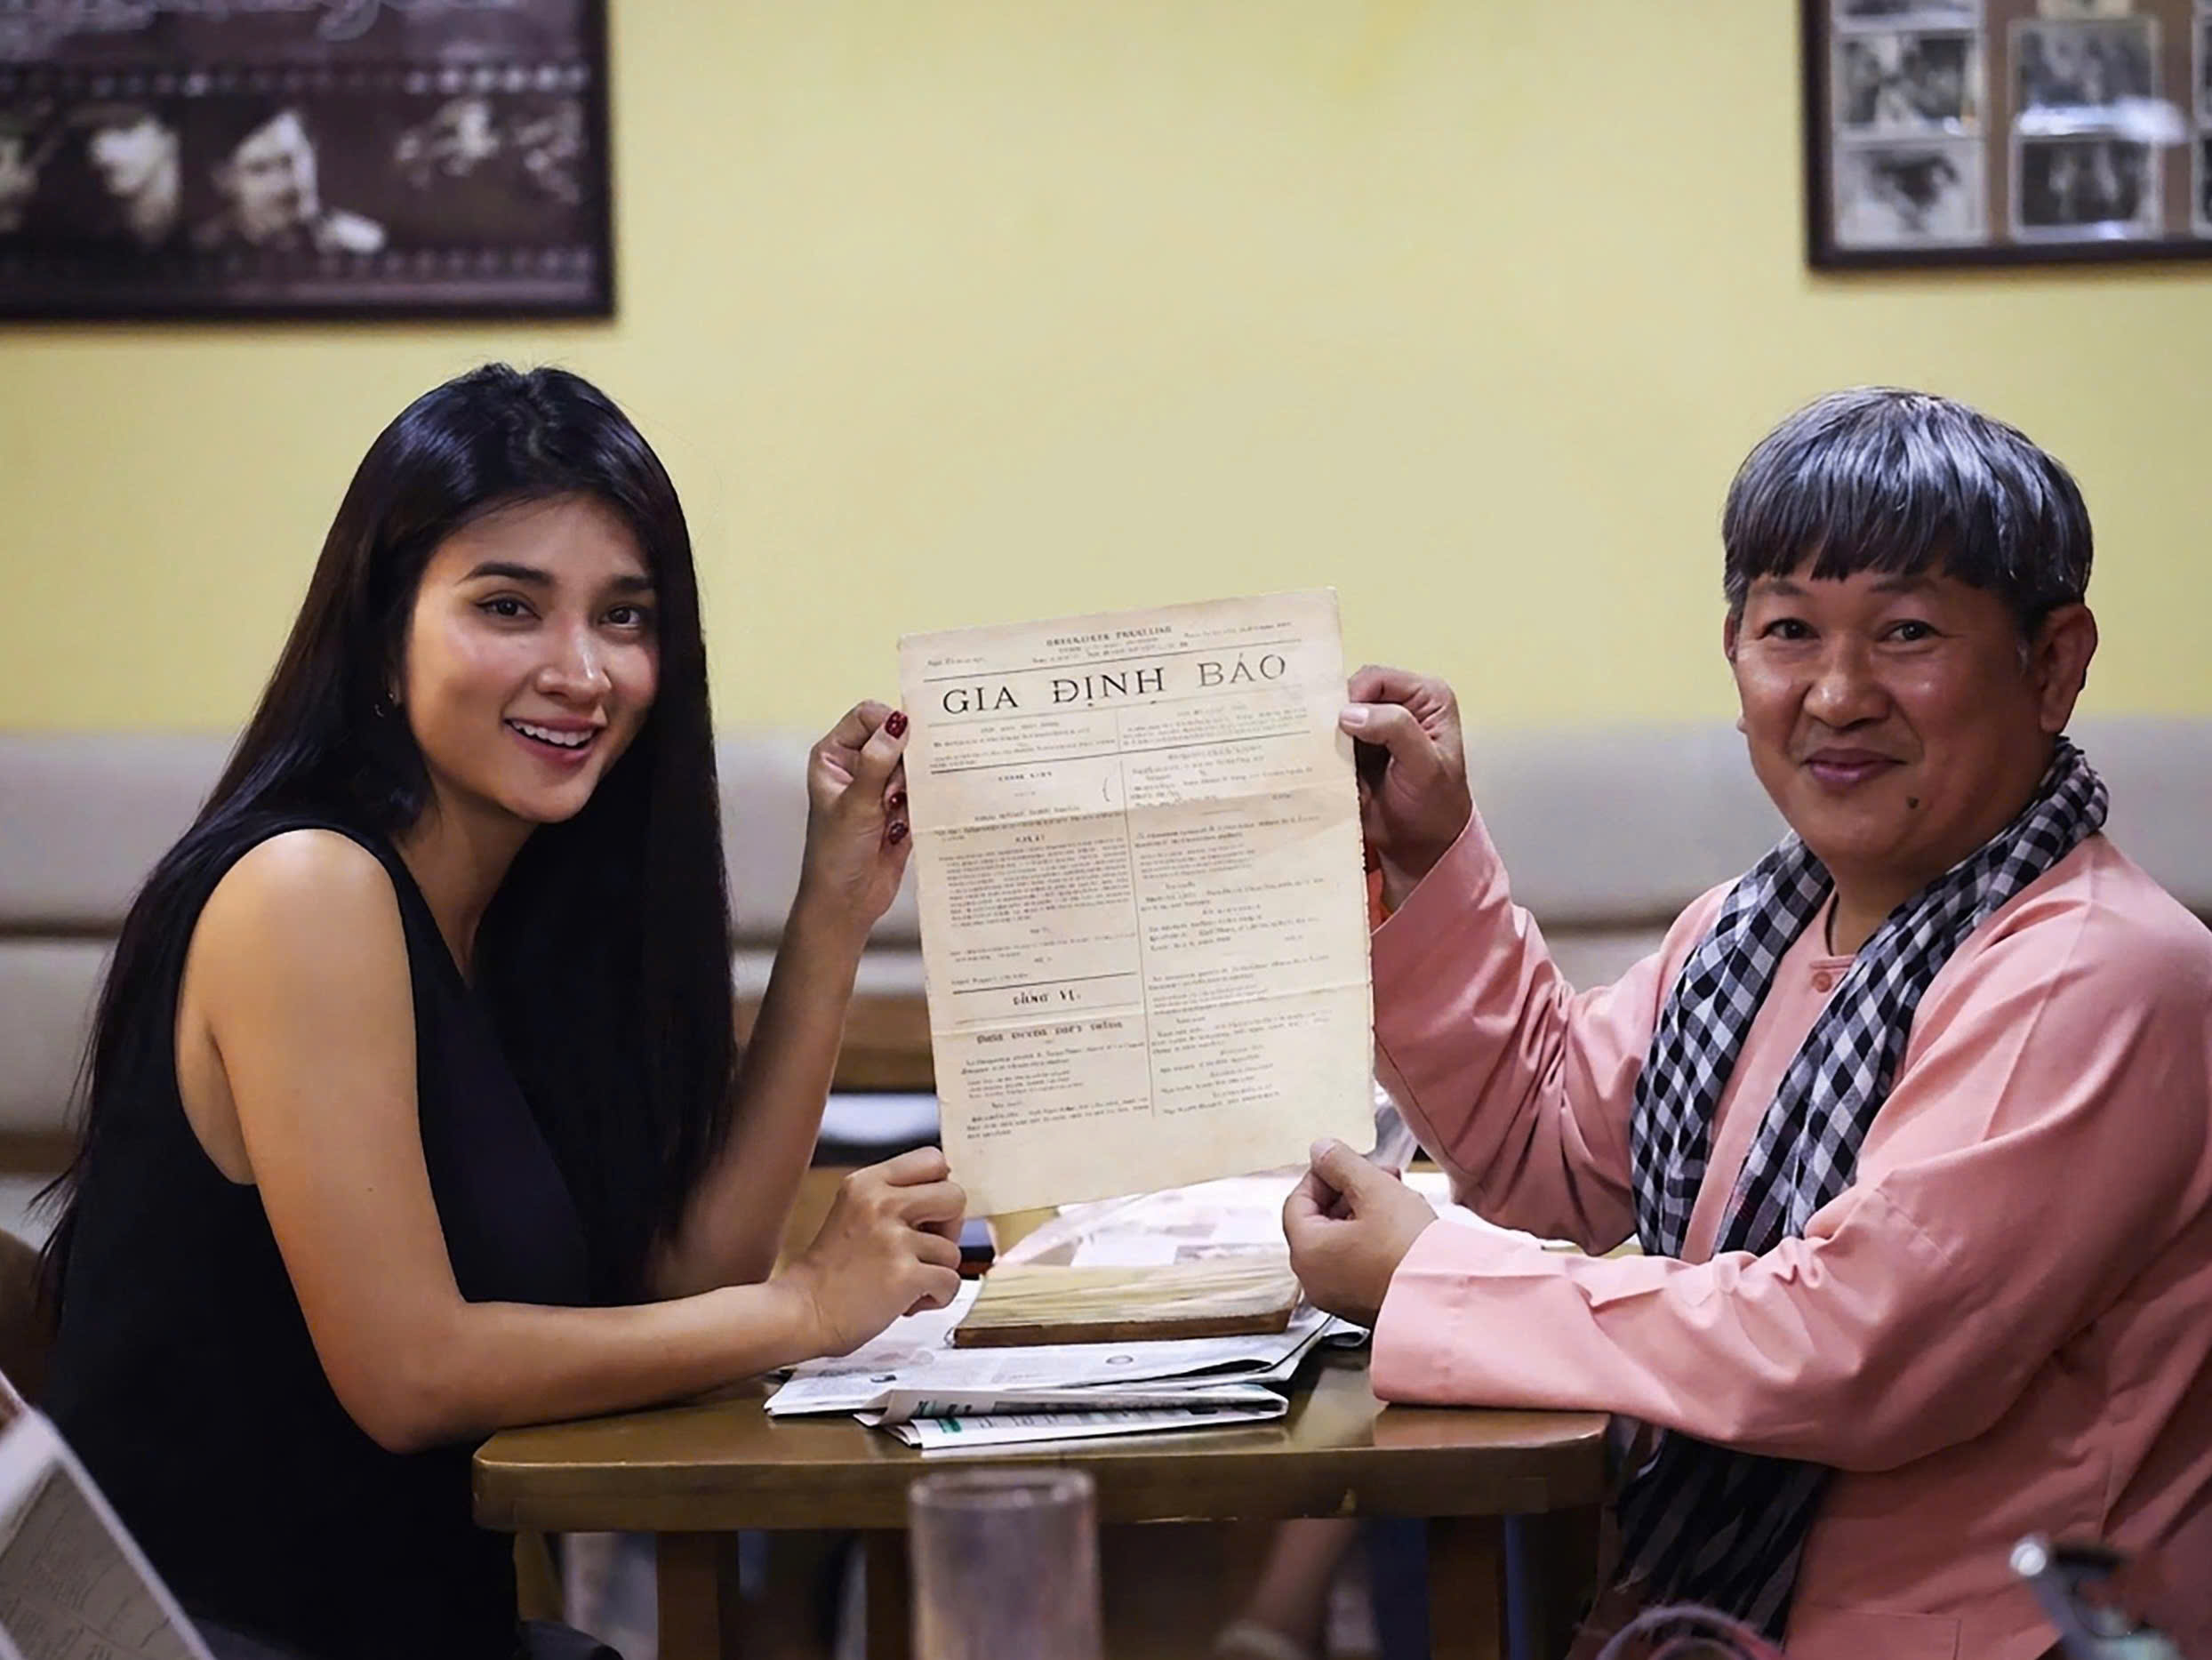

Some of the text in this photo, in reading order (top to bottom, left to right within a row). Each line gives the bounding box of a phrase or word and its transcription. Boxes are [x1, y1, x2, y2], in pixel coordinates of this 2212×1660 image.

[942, 652, 1286, 715] GIA ĐỊNH BÁO
